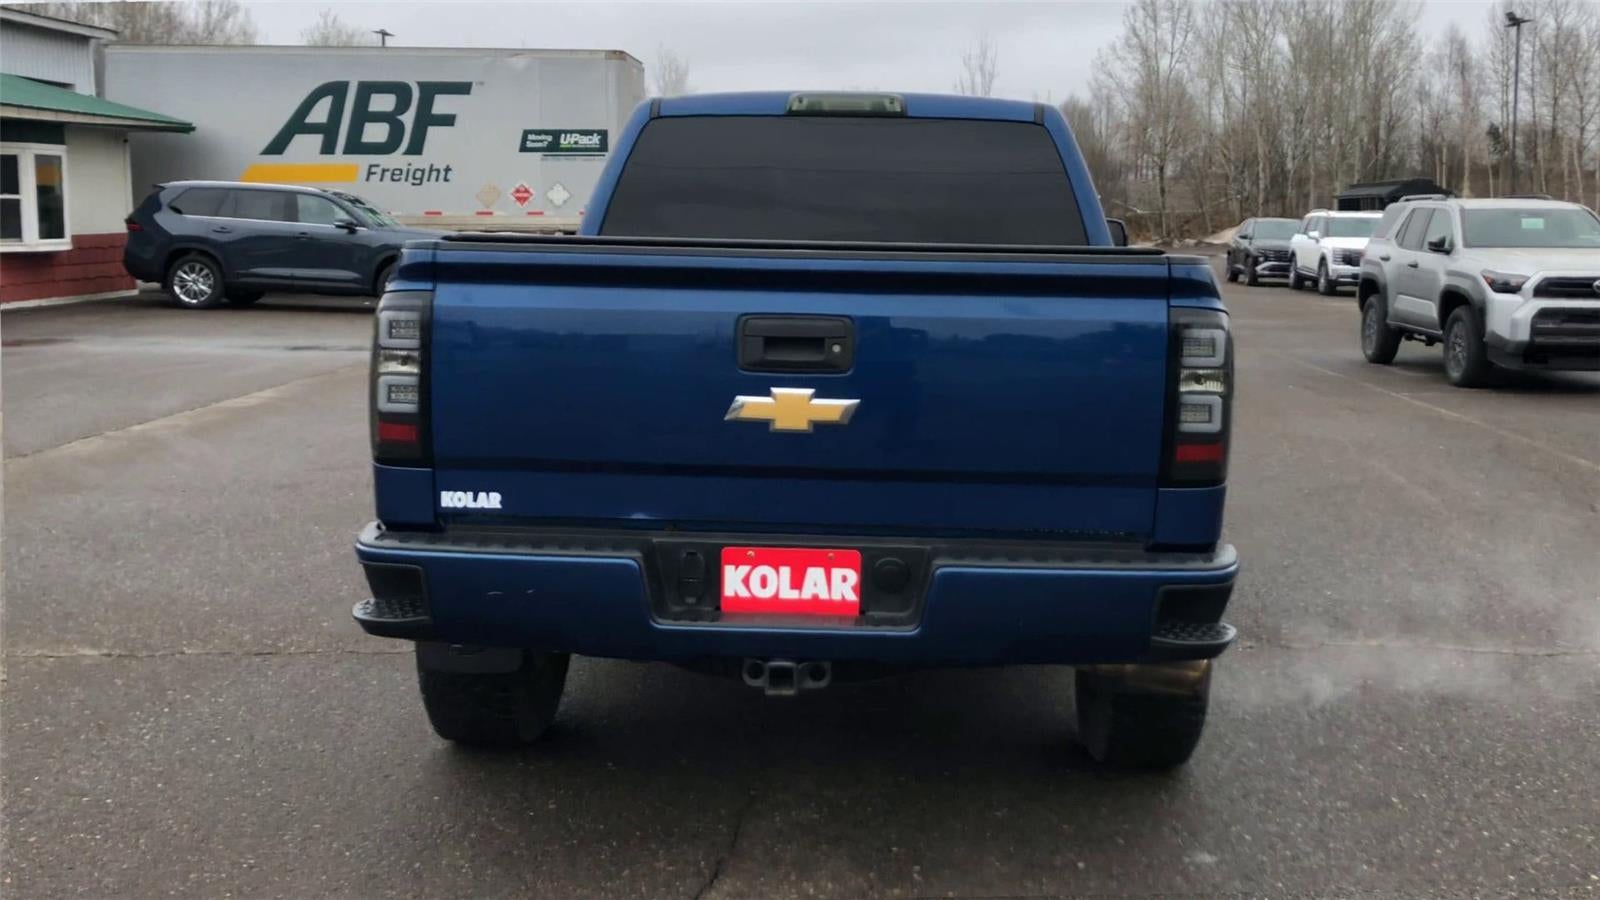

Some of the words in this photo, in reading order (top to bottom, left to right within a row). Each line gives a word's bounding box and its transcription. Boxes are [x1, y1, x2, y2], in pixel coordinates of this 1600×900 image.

[259, 81, 473, 155] ABF
[365, 163, 452, 186] Freight
[440, 491, 503, 509] KOLAR
[723, 565, 860, 601] KOLAR
